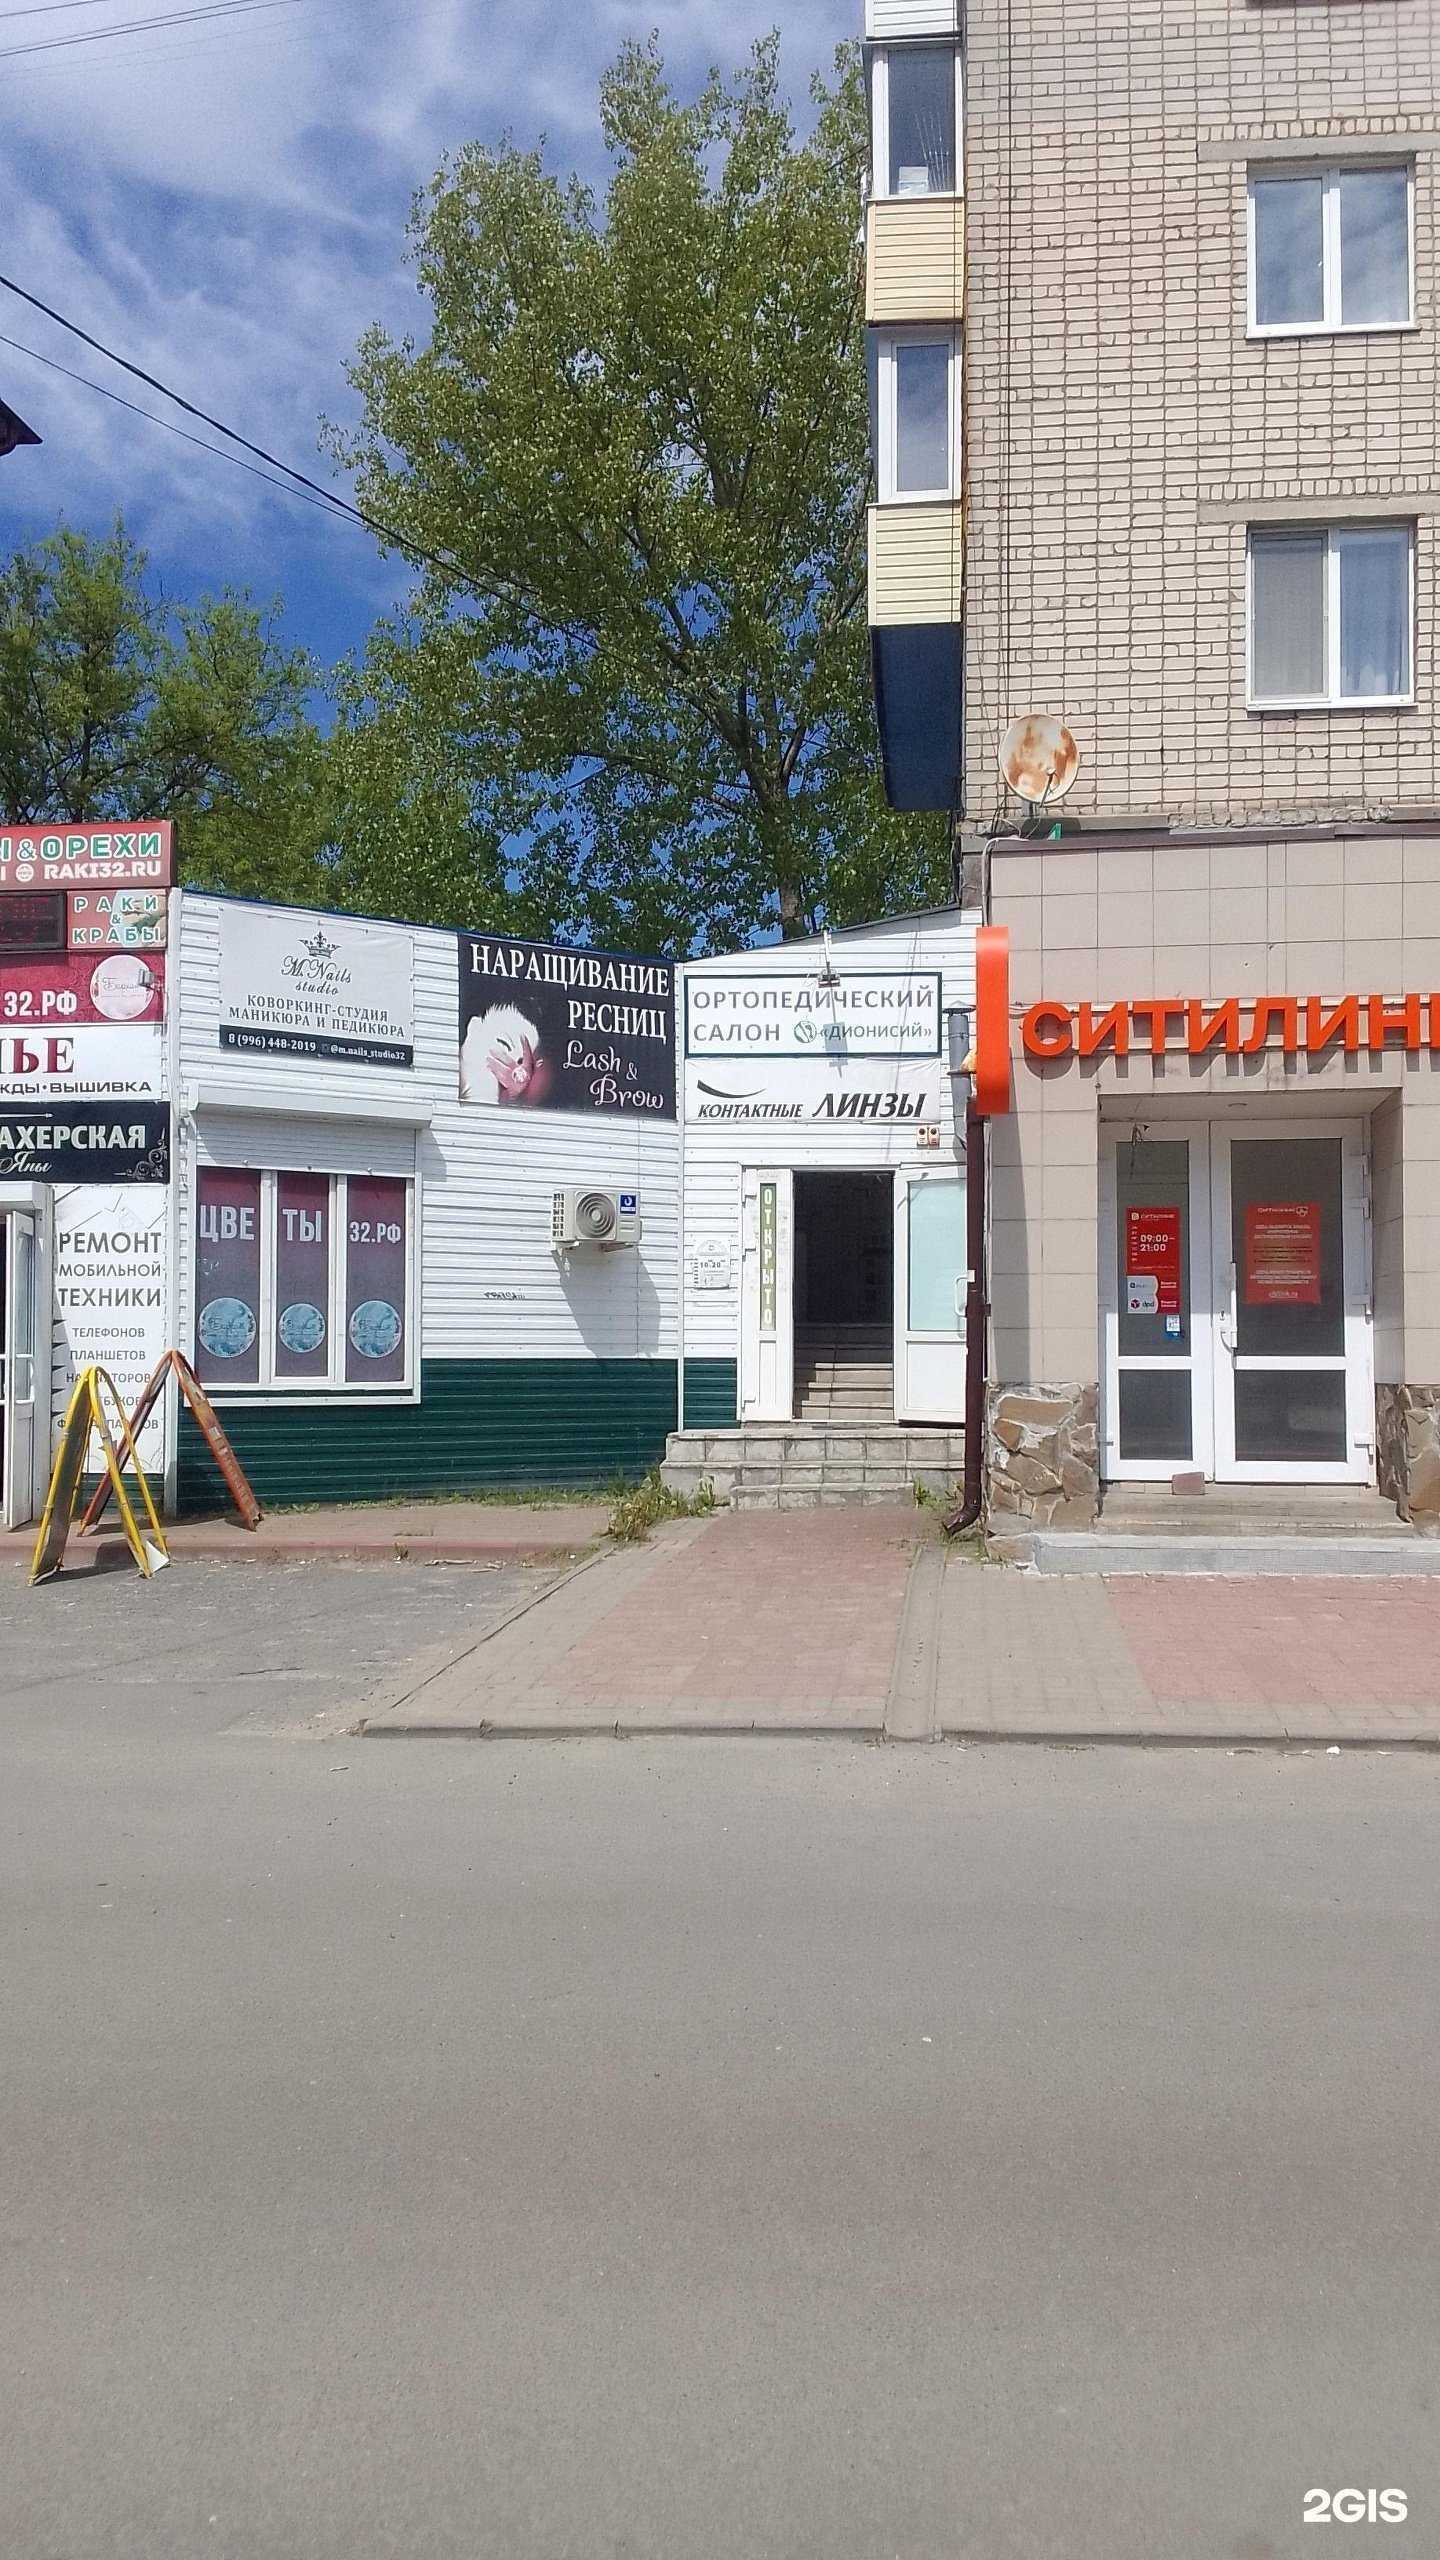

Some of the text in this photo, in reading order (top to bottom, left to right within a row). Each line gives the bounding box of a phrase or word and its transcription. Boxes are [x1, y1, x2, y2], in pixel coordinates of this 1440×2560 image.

[44, 861, 161, 880] RAKI32.RU
[74, 895, 158, 912] РАКИ
[110, 914, 121, 925] &
[72, 927, 161, 944] КРАБЫ
[470, 943, 670, 997] НАРАЩИВАНИЕ
[295, 980, 339, 996] studio
[693, 984, 932, 1013] ОРТОПЕДИЧЕСКИЙ
[4, 990, 77, 1017] 32.РФ
[247, 994, 388, 1022] КОВОРКИНГ-СТУДИЯ
[229, 1006, 405, 1038] МАНИКЮРА И ПЕДИКЮРА
[567, 999, 667, 1045] РЕСНИЦ
[693, 1023, 780, 1041] САЛОН
[228, 1033, 235, 1043] 8
[237, 1033, 266, 1049] (996)
[267, 1037, 316, 1051] 448-2019
[0, 1037, 75, 1074] ЬЕ
[563, 1040, 638, 1081] Lash &
[589, 1074, 664, 1109] Brow
[697, 1092, 927, 1118] КОНТАКТНЫЕ ЛИНЗЫ
[59, 1232, 162, 1253] РЕМОНТ
[350, 1221, 401, 1244] 32.РФ
[762, 1188, 774, 1325] ОТКРЫТО
[59, 1260, 161, 1277] МОБИЛЬНОЙ
[58, 1288, 161, 1307] ТЕХНИКИ
[72, 1327, 145, 1338] ТЕЛЕФОНОВ
[70, 1350, 146, 1360] ПЛАНШЕТОВ
